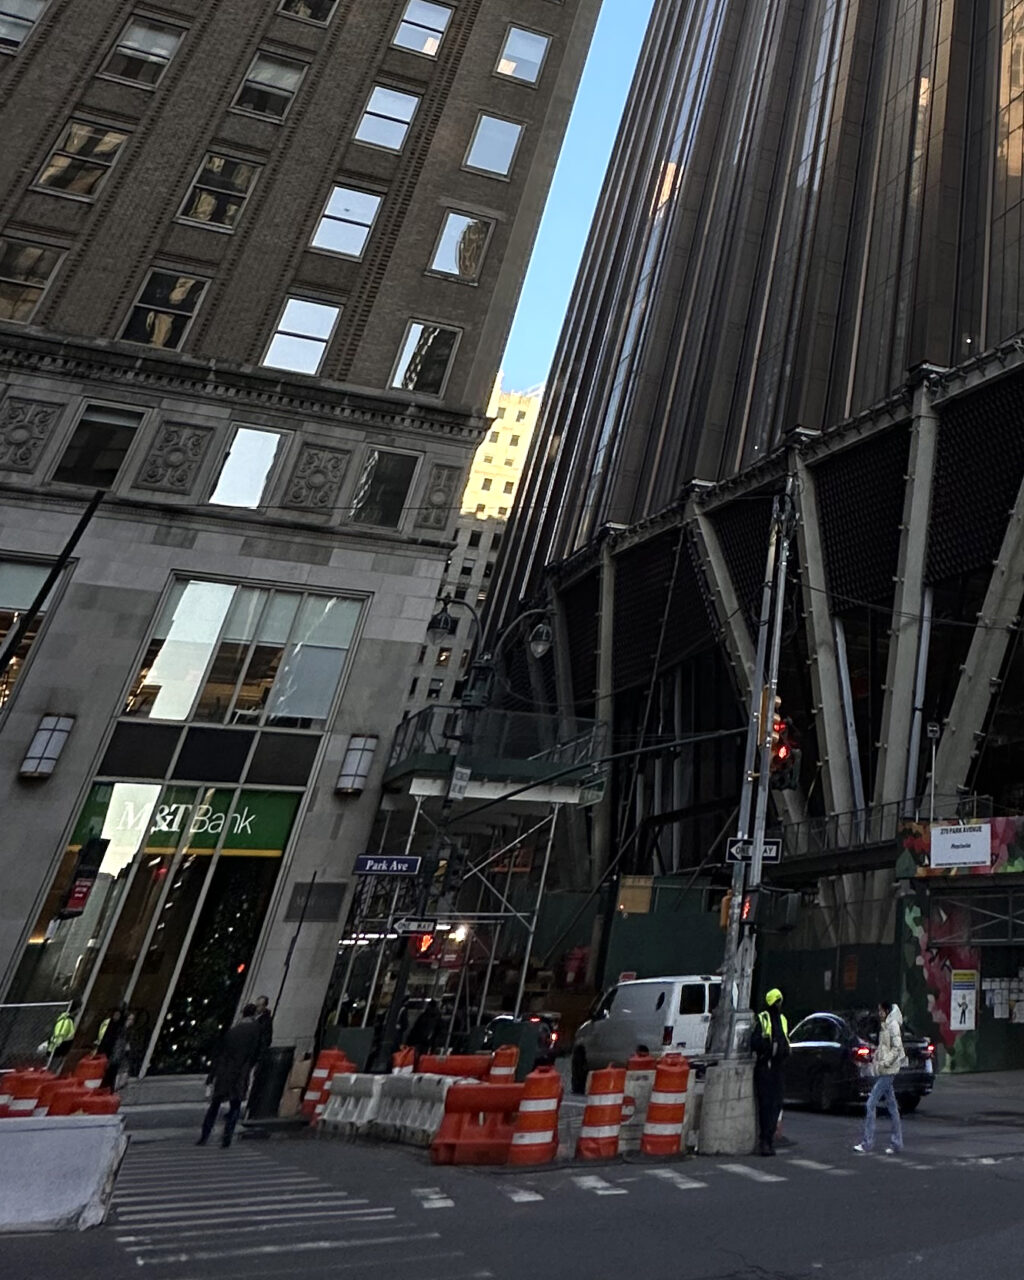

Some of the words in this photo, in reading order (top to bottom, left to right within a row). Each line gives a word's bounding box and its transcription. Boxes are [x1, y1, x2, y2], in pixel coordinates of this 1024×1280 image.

[116, 801, 192, 835] M&T
[190, 804, 257, 835] Bank
[365, 860, 388, 871] Park
[389, 860, 409, 871] Ave
[397, 922, 411, 930] ONE
